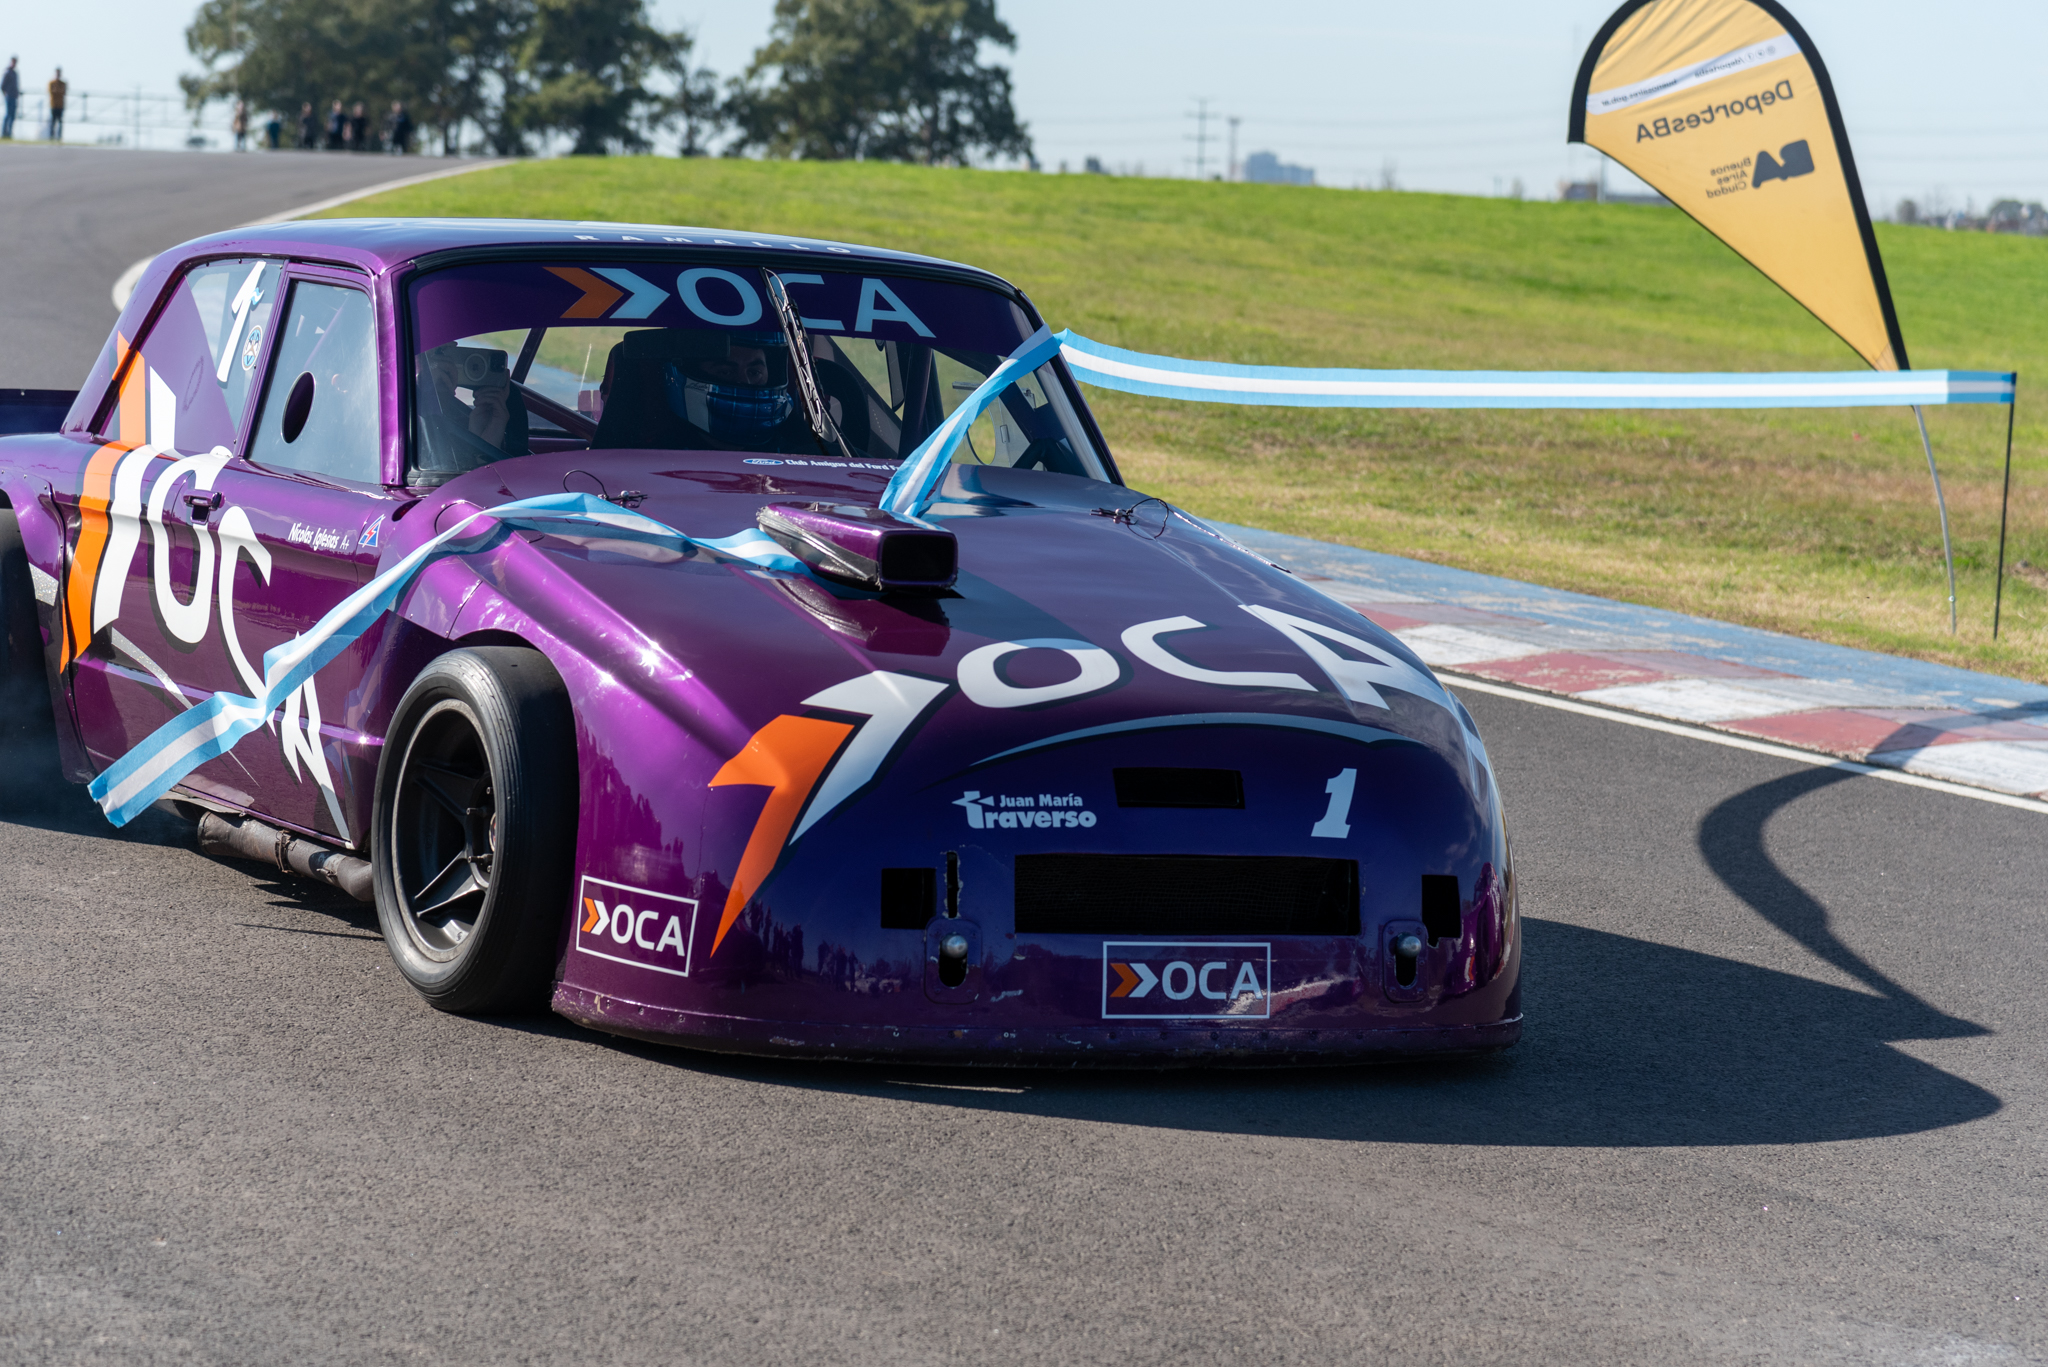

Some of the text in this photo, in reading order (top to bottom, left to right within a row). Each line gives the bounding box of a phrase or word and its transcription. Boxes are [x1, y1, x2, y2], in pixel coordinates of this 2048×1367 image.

[574, 234, 851, 253] RAMALLO
[676, 267, 937, 339] OCA
[809, 460, 848, 468] Amigos
[848, 461, 865, 469] del
[865, 463, 889, 471] Ford
[287, 522, 315, 545] Nicolas
[312, 527, 340, 551] Iglesias
[957, 604, 1480, 755] OCA
[999, 793, 1084, 808] Juan María
[1310, 767, 1358, 839] 1
[610, 904, 686, 957] OCA
[1161, 960, 1265, 1000] OCA
